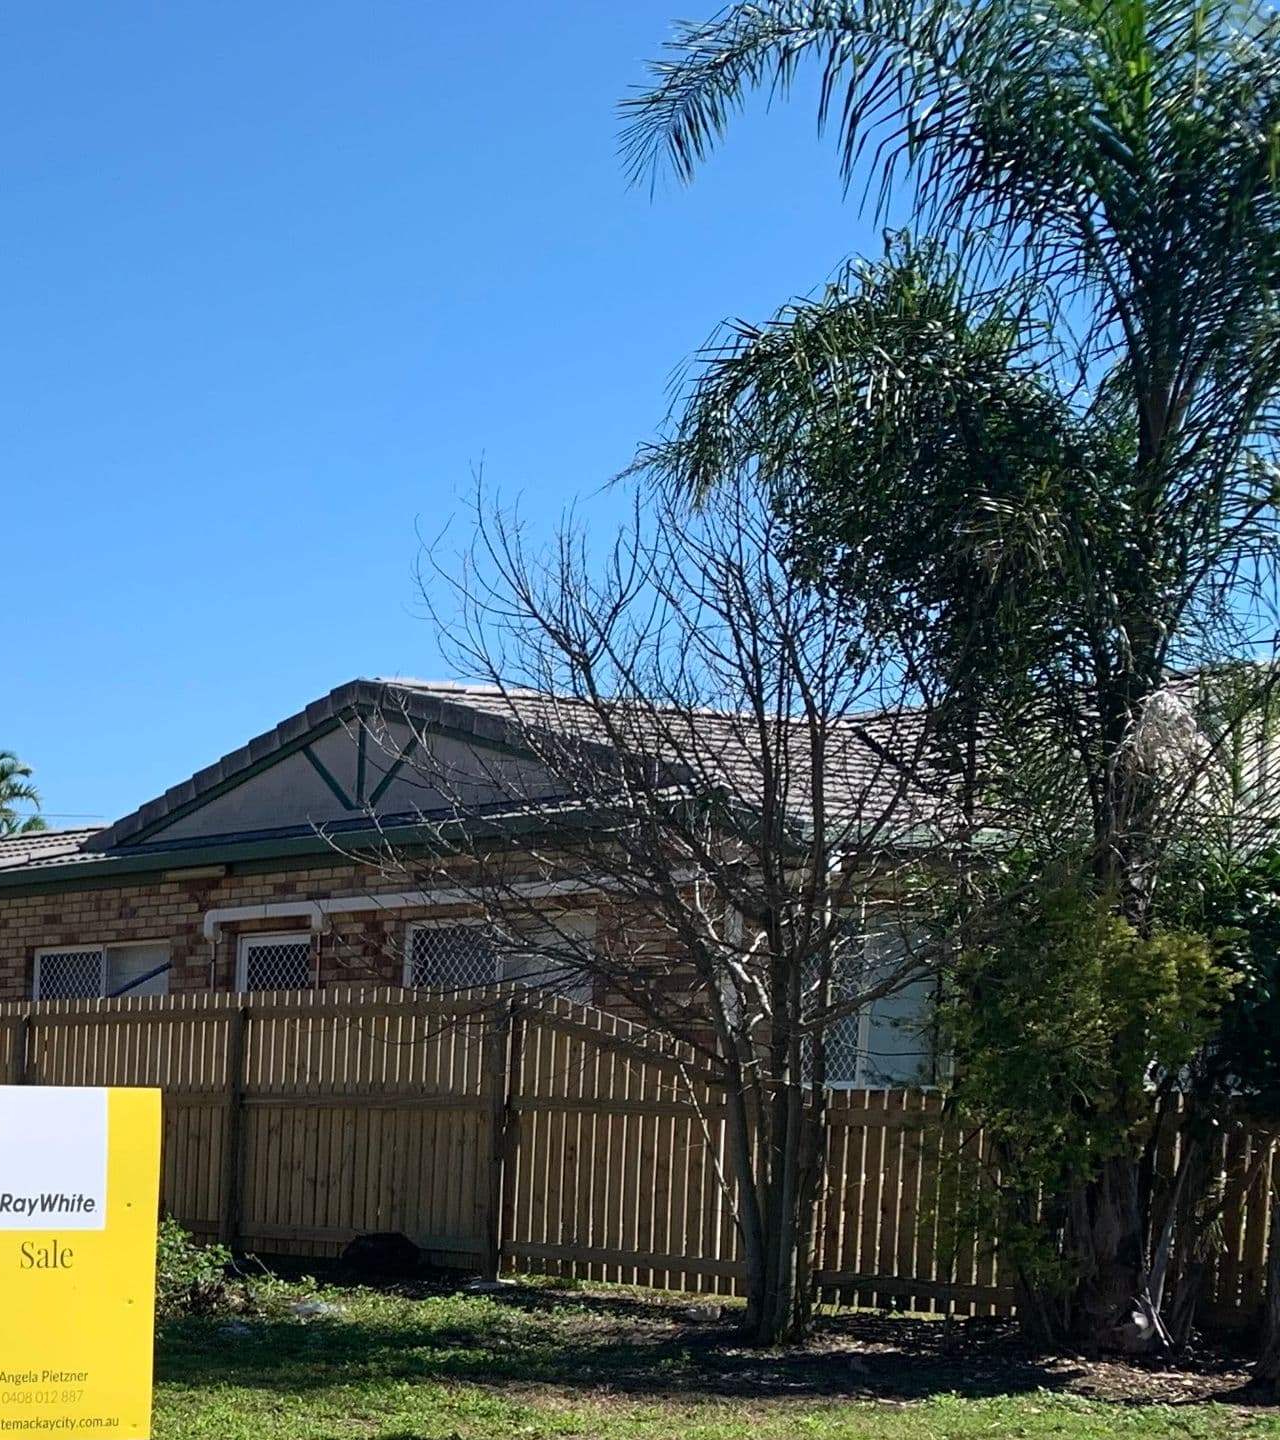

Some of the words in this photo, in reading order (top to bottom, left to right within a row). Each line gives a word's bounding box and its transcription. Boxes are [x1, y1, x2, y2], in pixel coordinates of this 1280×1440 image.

[20, 1239, 74, 1269] Sale
[42, 1370, 88, 1383] Pietzner
[1, 1391, 33, 1404] 0408
[35, 1390, 58, 1404] 012
[61, 1390, 84, 1403] 887
